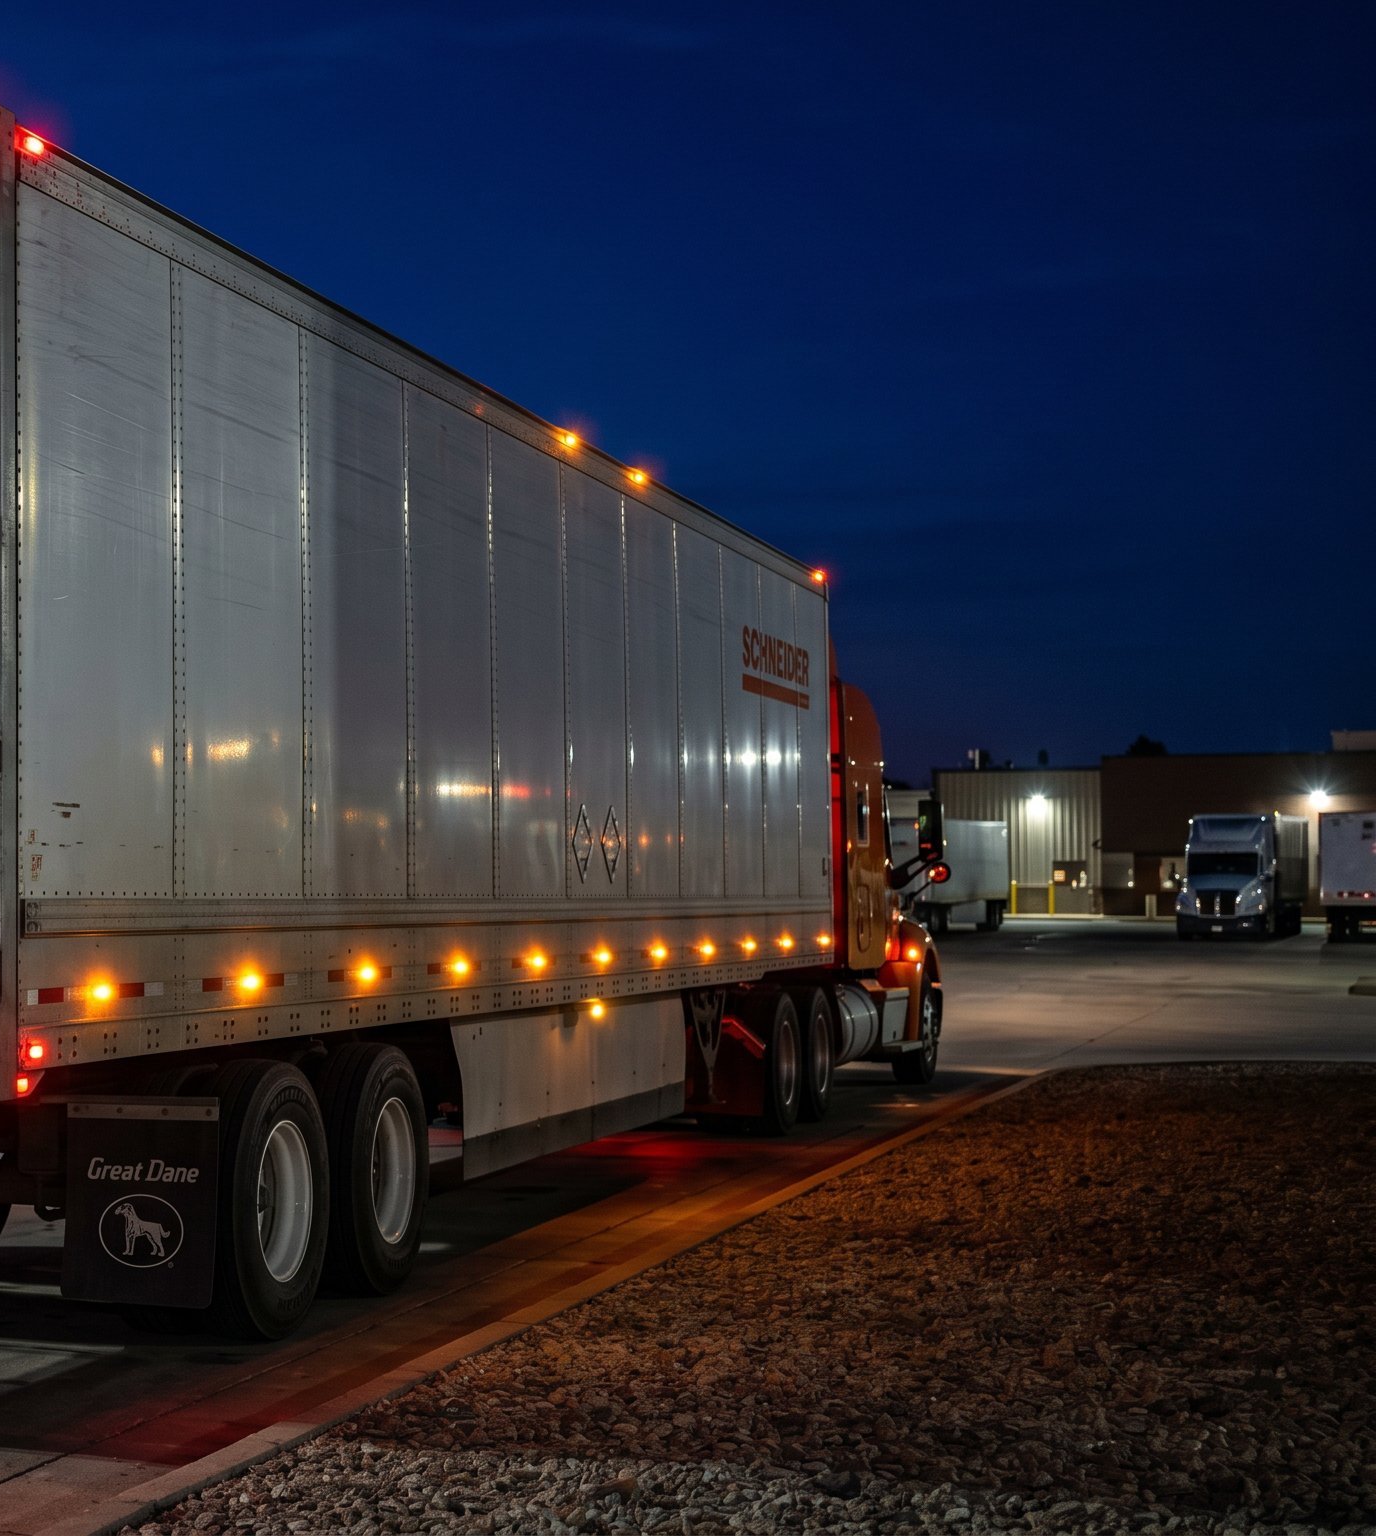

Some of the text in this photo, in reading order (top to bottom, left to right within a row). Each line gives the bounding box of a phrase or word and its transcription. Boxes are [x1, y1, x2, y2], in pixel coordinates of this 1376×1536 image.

[742, 624, 809, 688] SCHNEIDER
[87, 1156, 200, 1184] Great Dane
